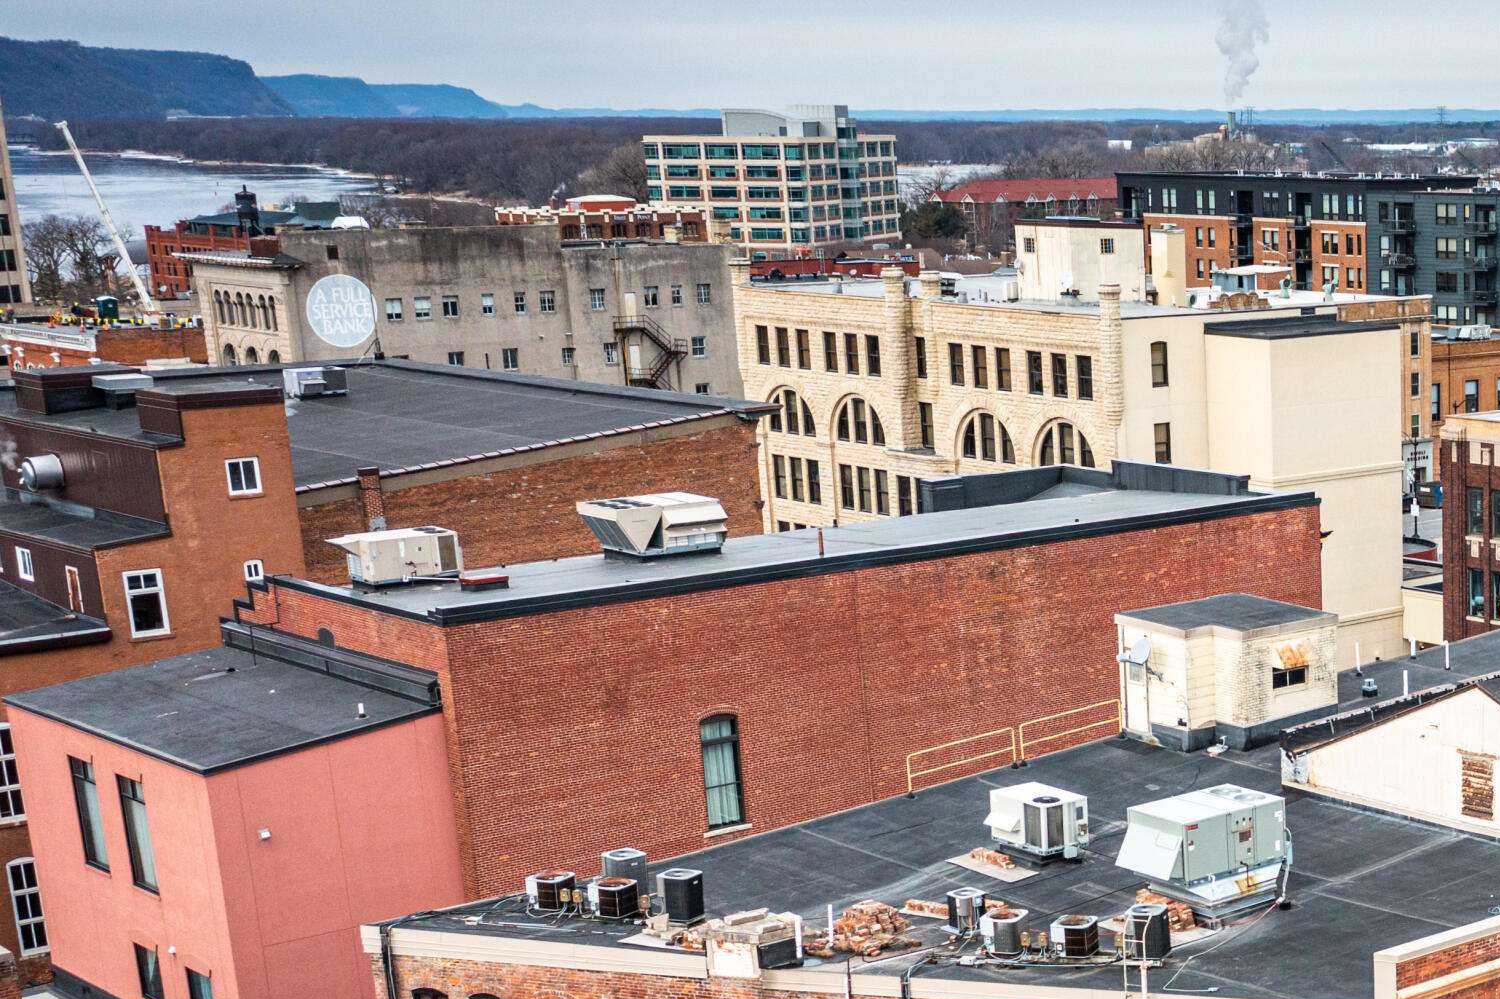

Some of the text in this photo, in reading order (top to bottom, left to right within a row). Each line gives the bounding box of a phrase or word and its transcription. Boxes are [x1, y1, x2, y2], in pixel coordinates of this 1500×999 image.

[315, 287, 366, 303] A FULL
[312, 302, 372, 320] SERVICE
[323, 318, 368, 334] BANK
